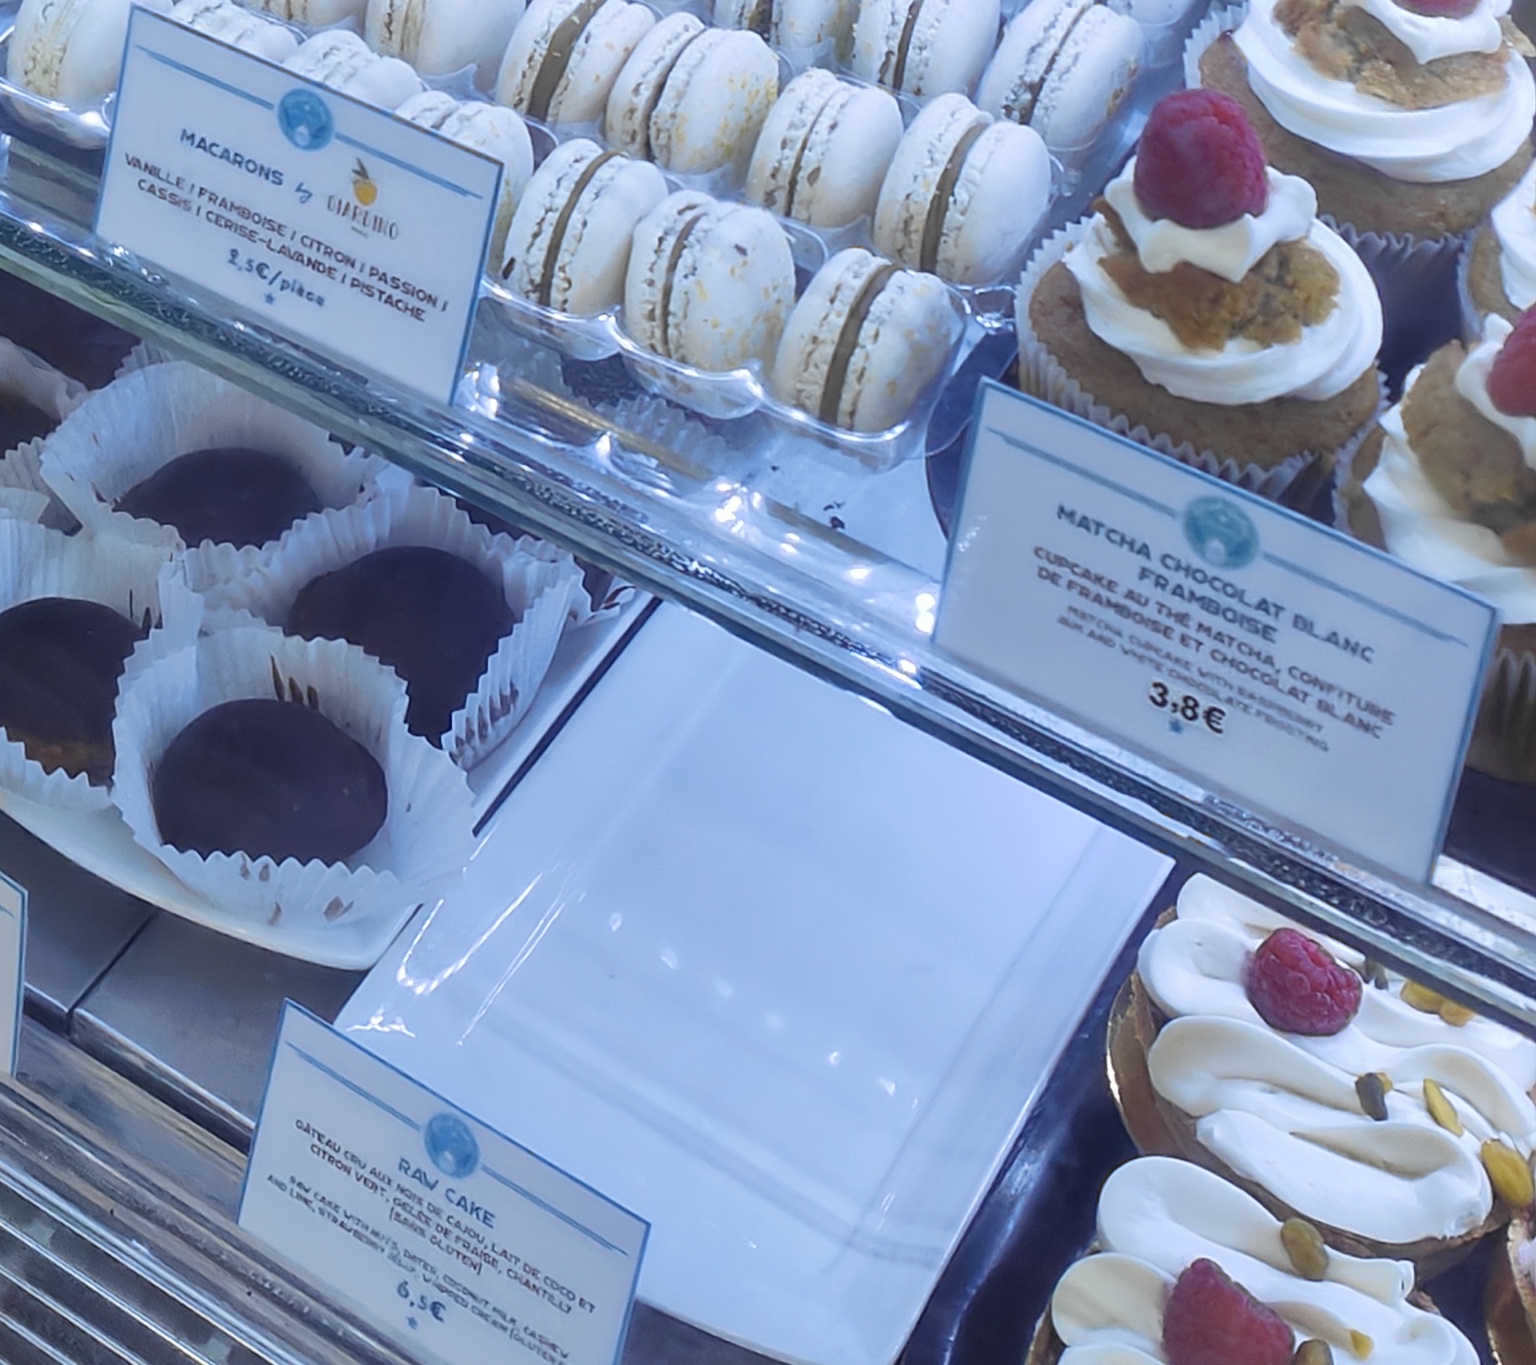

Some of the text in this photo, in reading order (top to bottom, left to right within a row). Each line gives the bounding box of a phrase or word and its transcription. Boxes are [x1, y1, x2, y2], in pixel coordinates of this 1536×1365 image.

[181, 129, 283, 185] MACARONS
[295, 182, 312, 204] by
[125, 153, 437, 307] VANILLE FRAMBOISE CITRON PASSION
[138, 179, 426, 322] CASSIS CERISE-LAVANDE PISTACHE
[1034, 547, 1395, 725] CUPCAKE AU THÉ MATCHA, CONFITURE
[1057, 505, 1374, 663] MATCHA CHOCOLAT BLANC
[1139, 567, 1277, 643] FRAMBOISE
[1038, 567, 1382, 739] DE FRAMBOISE ET CHOCOLAT BLANC
[1149, 682, 1226, 734] 3,8€
[296, 1120, 341, 1153] GÂTEAU
[344, 1151, 366, 1169] CRU
[369, 1168, 392, 1186] AUX
[427, 1202, 443, 1219] DE
[446, 1215, 488, 1250] CAJOU,
[491, 1243, 520, 1266] LAIT
[523, 1263, 540, 1280] DE
[543, 1276, 576, 1301] COCO
[579, 1298, 595, 1313] ET
[311, 1144, 352, 1175] CITRON
[355, 1171, 389, 1202] VERT,
[435, 1223, 452, 1239] DE
[455, 1235, 502, 1274] FRAISE,
[507, 1268, 572, 1314] CHANTILLY
[399, 1158, 495, 1229] RAW CAKE
[397, 1280, 446, 1322] 6,5€
[430, 1235, 482, 1276] GLUTEN)
